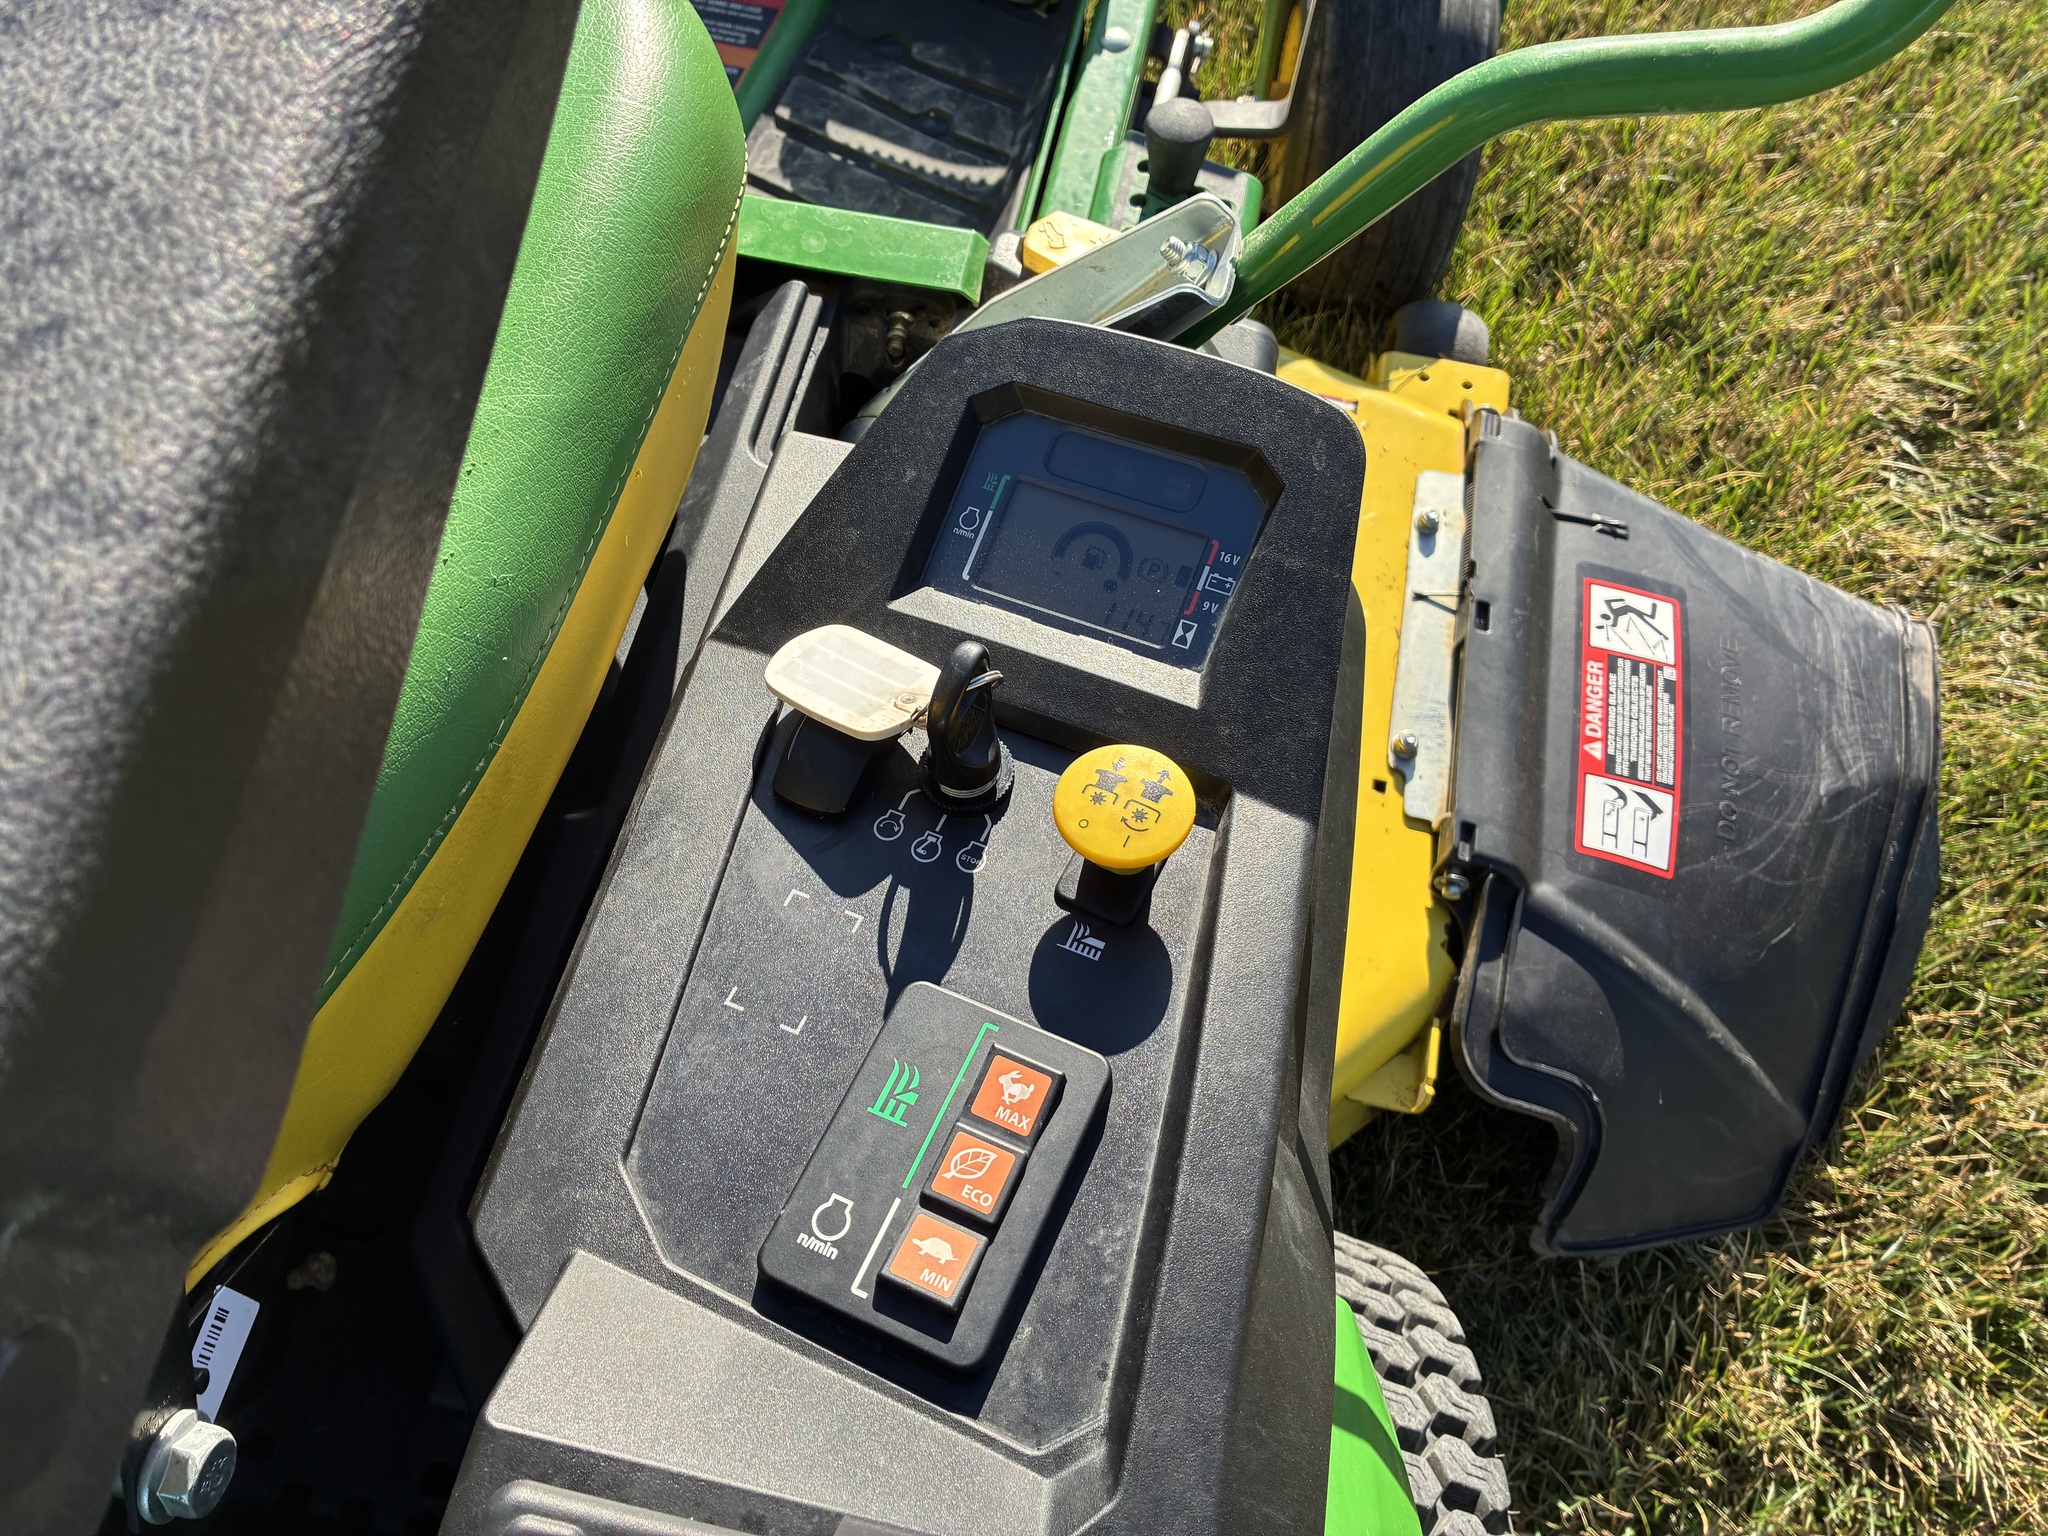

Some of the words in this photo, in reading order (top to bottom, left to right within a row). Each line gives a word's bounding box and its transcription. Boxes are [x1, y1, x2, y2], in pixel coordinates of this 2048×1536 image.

[1220, 551, 1232, 563] 16
[1232, 555, 1241, 566] V
[1202, 601, 1210, 611] 9
[1211, 603, 1219, 614] V
[1584, 659, 1605, 740] DANGER
[1719, 636, 1743, 738] REMOVE
[1719, 742, 1742, 797] NOT
[1716, 800, 1739, 843] DO
[995, 1105, 1032, 1131] MAX
[960, 1184, 994, 1208] ECO
[796, 1232, 839, 1260] n/min
[919, 1268, 954, 1292] MIN
